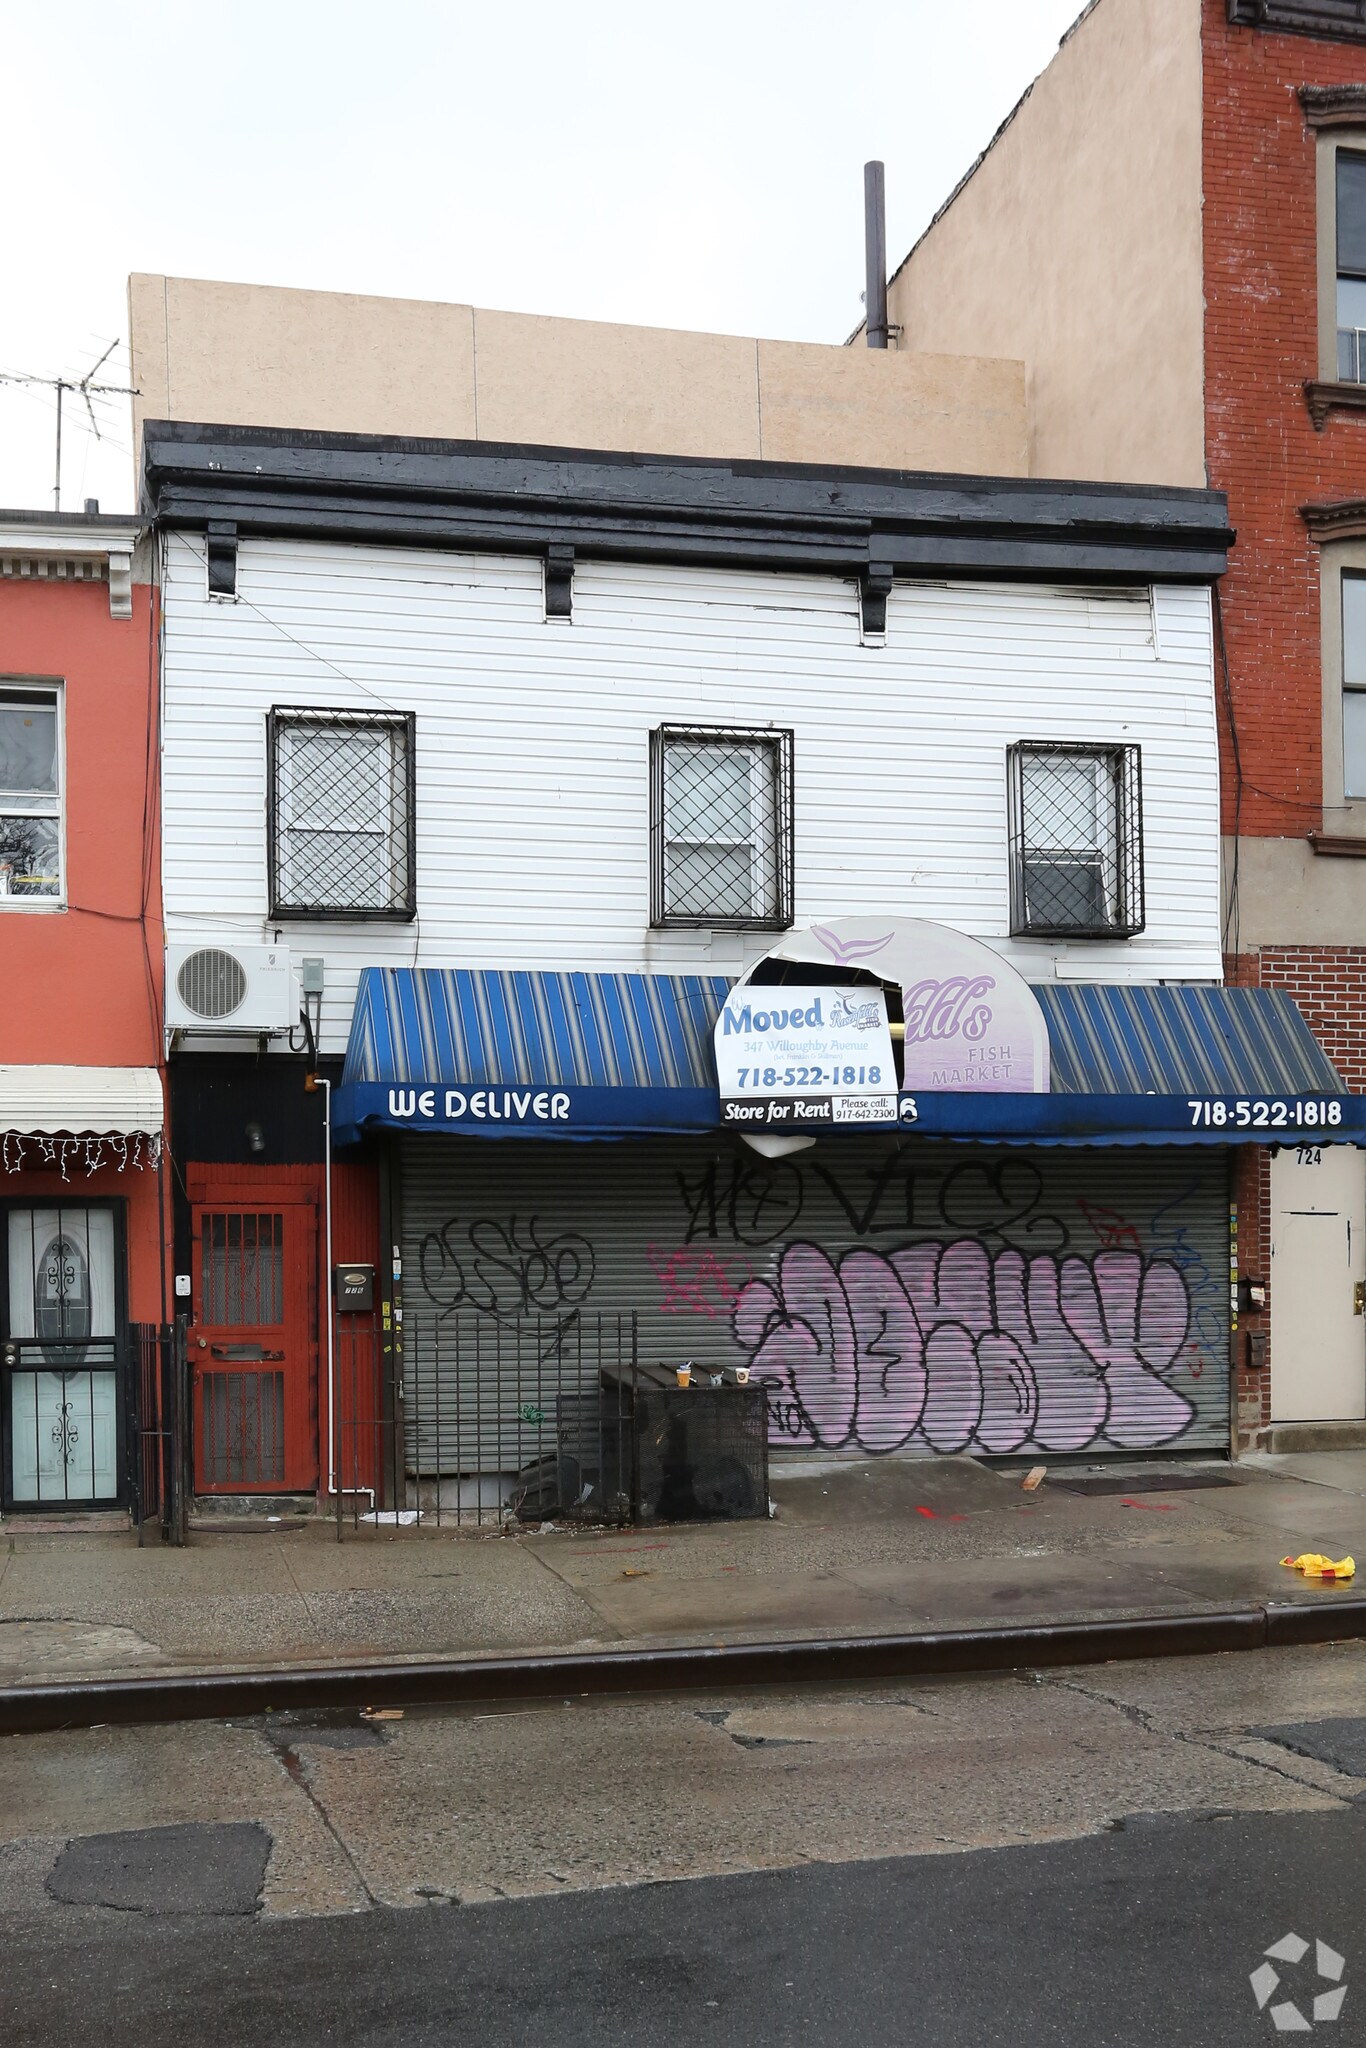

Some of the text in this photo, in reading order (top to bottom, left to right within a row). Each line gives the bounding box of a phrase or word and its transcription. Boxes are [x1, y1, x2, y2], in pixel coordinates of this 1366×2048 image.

[723, 997, 824, 1035] Moved
[743, 1039, 869, 1054] 347 Willoughby Avenue
[968, 1045, 1012, 1063] FISH
[737, 1066, 882, 1088] 718-522-1818
[931, 1064, 1013, 1085] MARKET
[388, 1089, 571, 1120] WE DELIVER
[725, 1100, 830, 1123] Store for Rent
[841, 1099, 889, 1108] Please call:
[835, 1109, 895, 1120] 917-642-2300
[1296, 1149, 1322, 1165] 724
